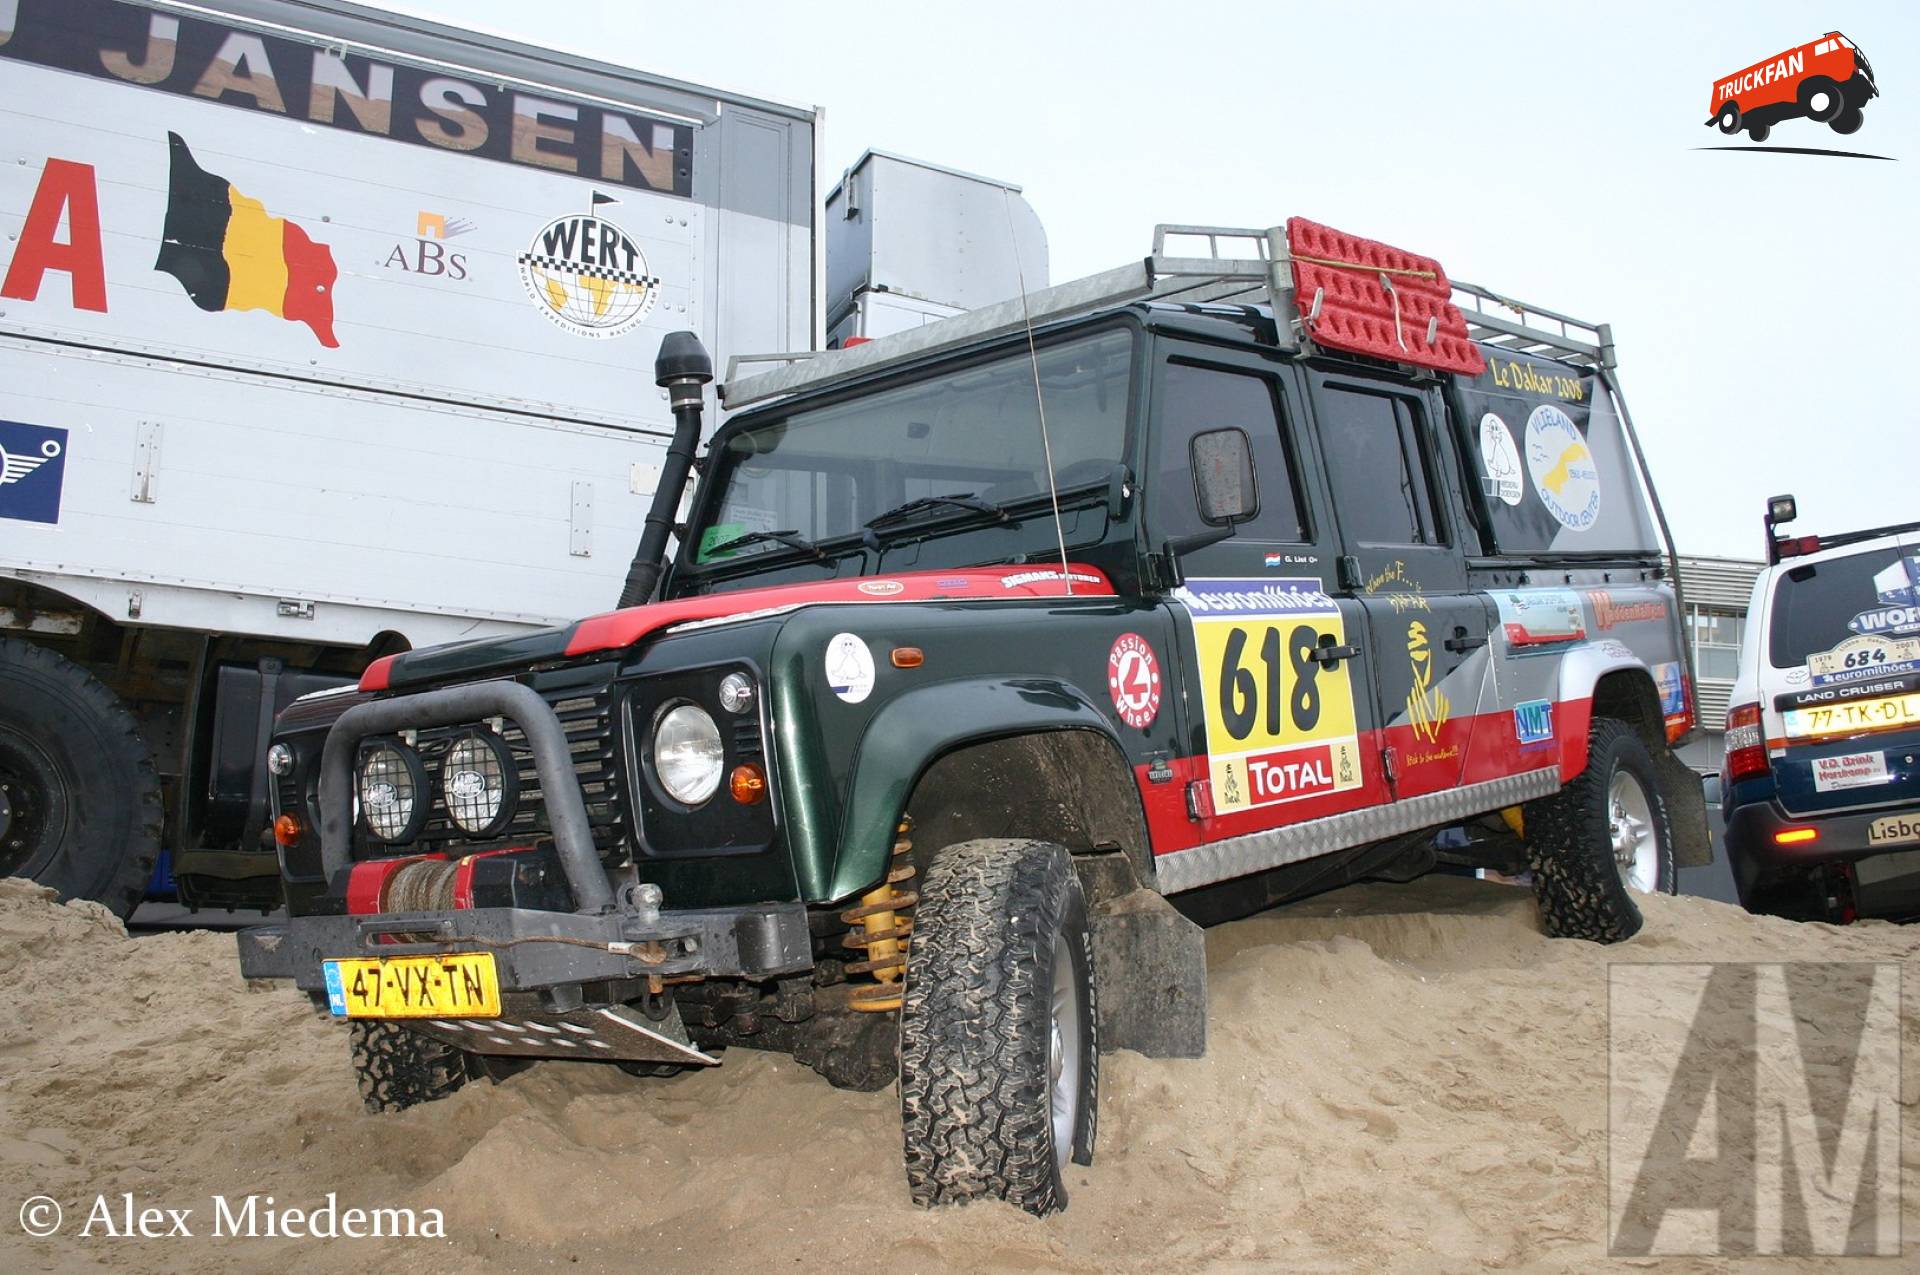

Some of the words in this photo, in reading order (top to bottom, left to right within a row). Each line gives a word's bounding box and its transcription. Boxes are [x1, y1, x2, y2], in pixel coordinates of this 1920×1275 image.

[99, 13, 674, 192] JANSEN
[0, 156, 108, 313] A
[542, 218, 639, 272] WERT
[384, 238, 467, 281] ABS
[519, 266, 536, 300] WORLD
[539, 305, 601, 338] EXPEDITIONS
[609, 318, 642, 337] RACING
[644, 291, 657, 314] TEAM
[1490, 357, 1508, 386] Le
[1509, 361, 1552, 395] Dakar
[1554, 376, 1584, 400] 2008
[1531, 408, 1577, 441] VLIELAND
[1540, 488, 1580, 528] OUTDOOR
[1110, 636, 1153, 668] Passion
[1834, 661, 1914, 682] euromilhões
[1844, 648, 1886, 668] 684
[1123, 656, 1148, 704] 4
[1220, 624, 1321, 741] 618
[1796, 691, 1835, 703] LAND
[1839, 681, 1904, 697] CRUISER
[1116, 693, 1160, 728] Wheels
[1516, 704, 1552, 737] NMT
[1808, 699, 1915, 729] 77-TK-DL
[331, 993, 345, 1007] NL
[352, 964, 484, 1007] 47-VX-TN
